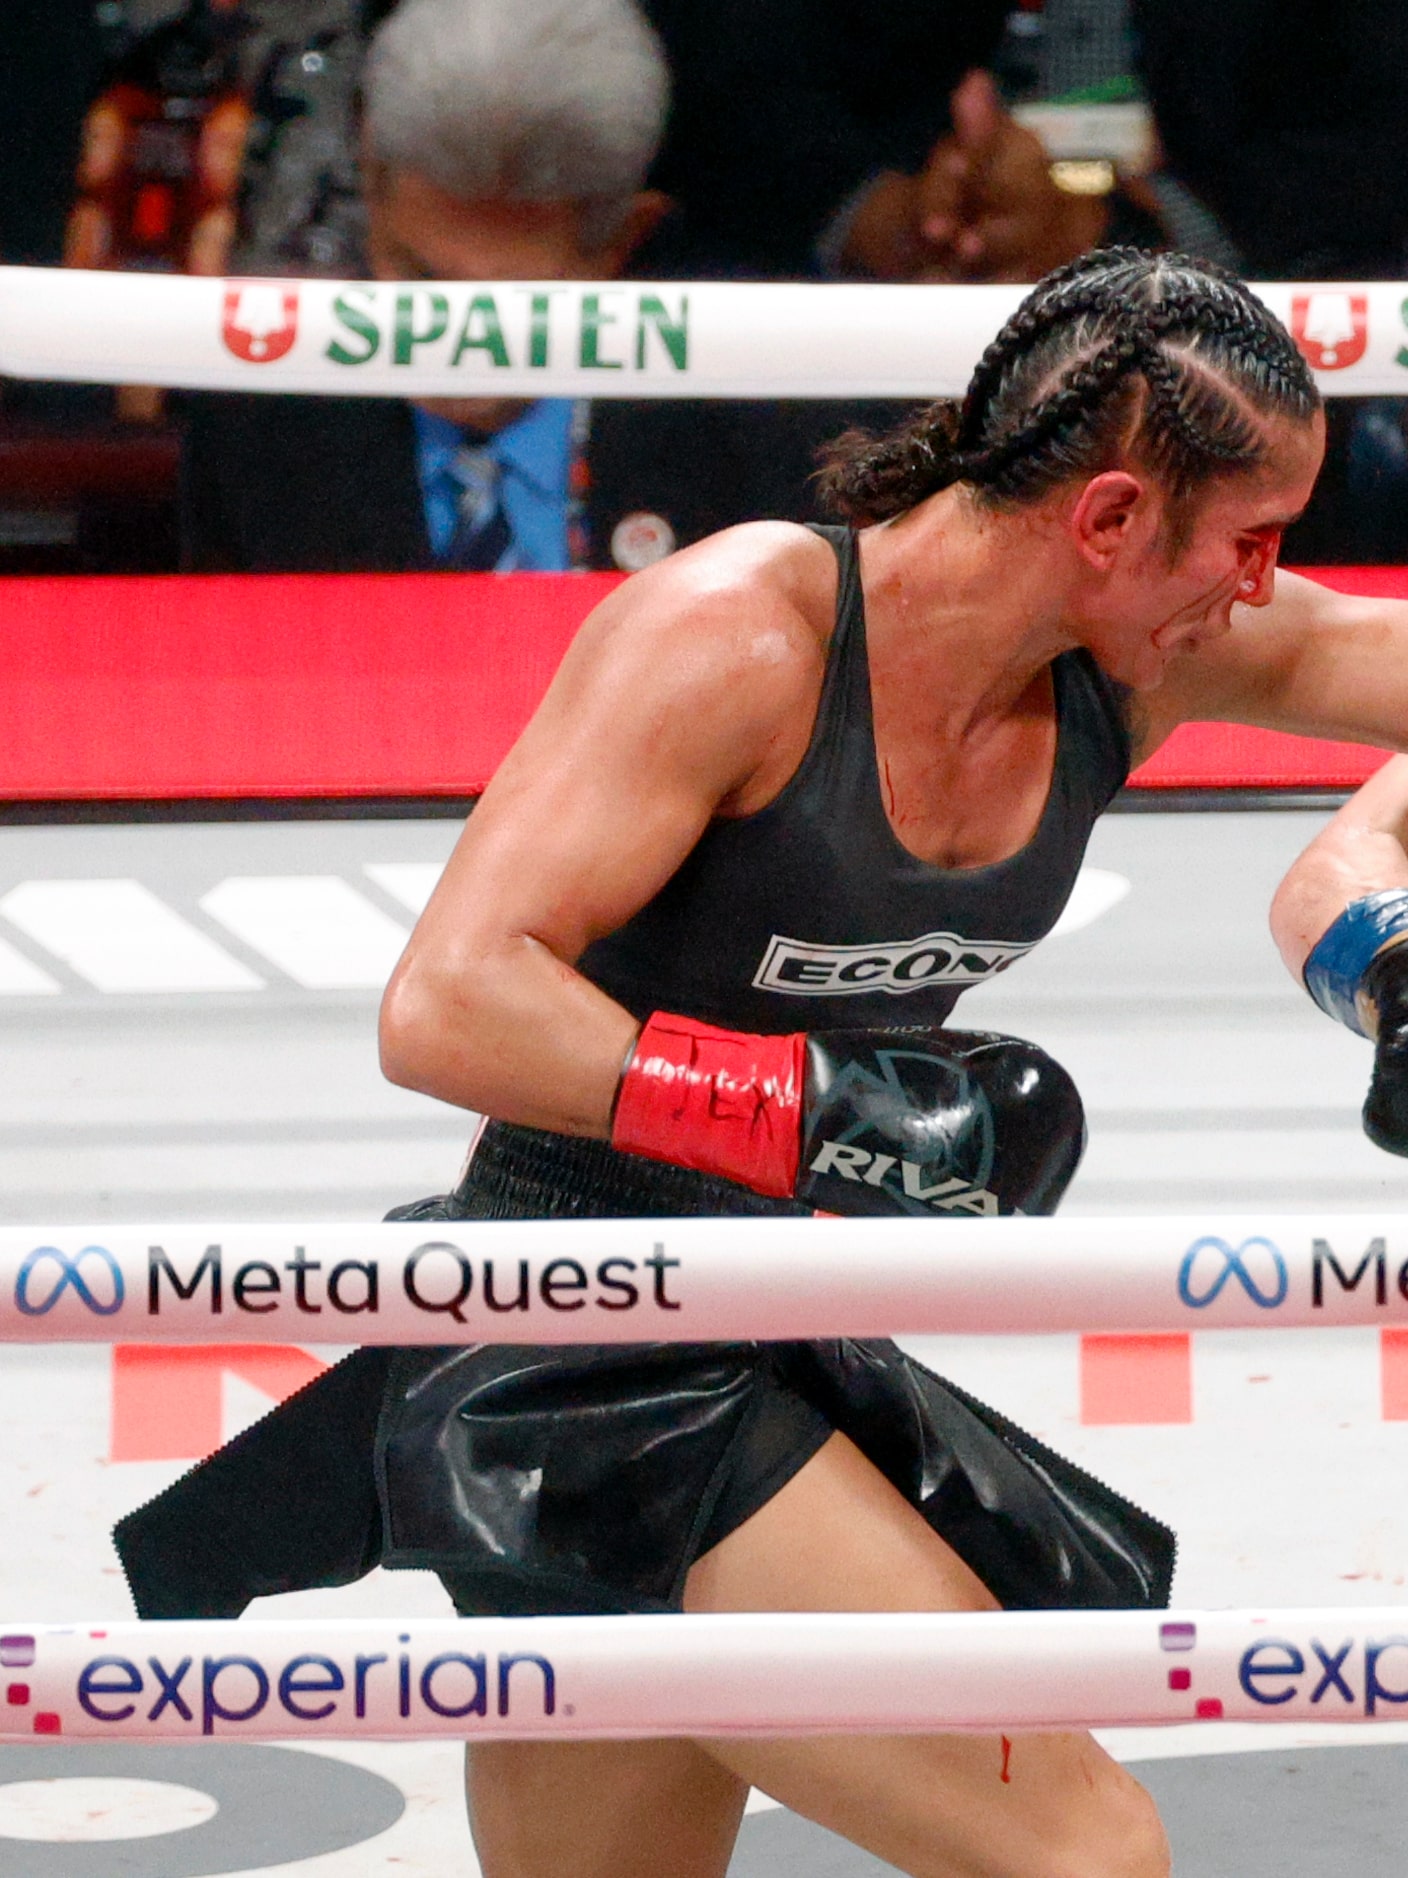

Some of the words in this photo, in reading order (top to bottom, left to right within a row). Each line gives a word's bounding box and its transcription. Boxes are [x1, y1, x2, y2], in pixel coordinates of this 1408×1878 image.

[325, 282, 689, 371] SPATEN
[809, 1138, 1024, 1218] RIVA
[146, 1244, 379, 1315] Meta
[402, 1241, 682, 1324] Quest
[77, 1632, 557, 1736] experian
